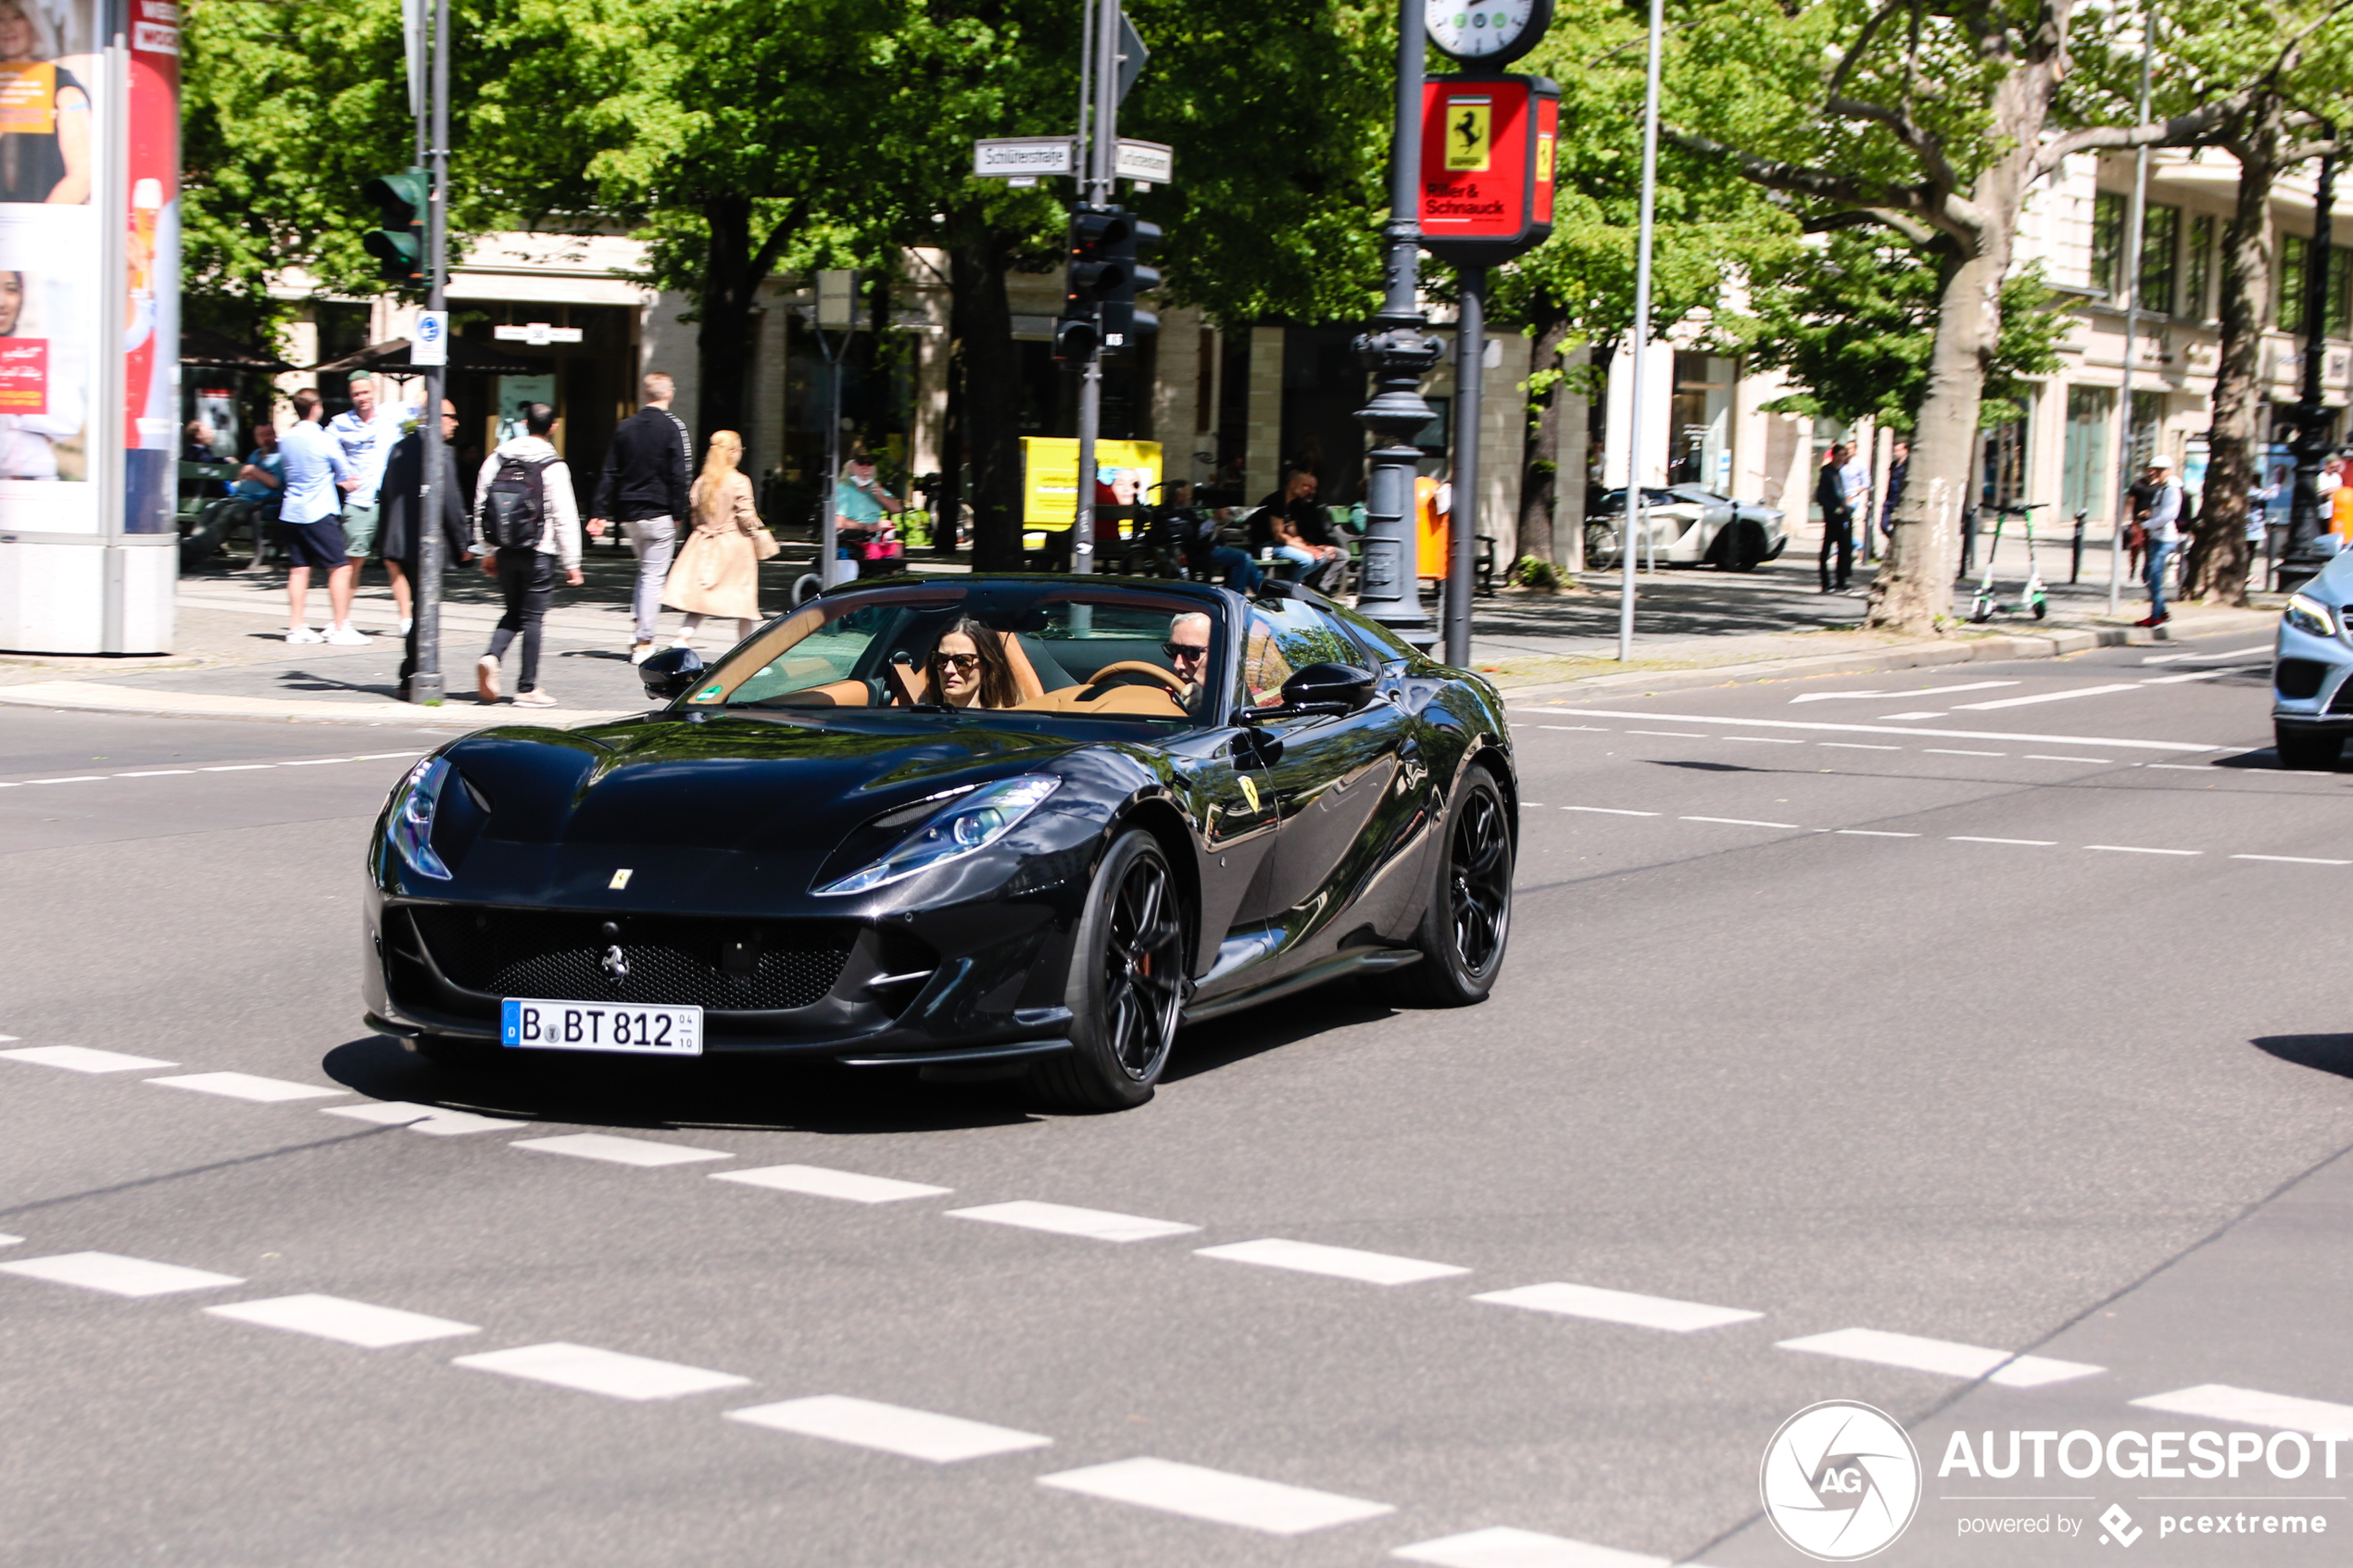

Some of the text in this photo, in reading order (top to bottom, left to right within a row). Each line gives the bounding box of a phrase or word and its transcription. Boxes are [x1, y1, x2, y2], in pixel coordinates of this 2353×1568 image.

[984, 147, 1064, 167] Schlüterstraße
[1467, 183, 1478, 197] &
[1426, 199, 1504, 214] Schnauck
[679, 1014, 693, 1023] 04
[508, 1026, 516, 1038] D
[522, 1008, 673, 1047] B BT 812
[679, 1037, 693, 1047] 10
